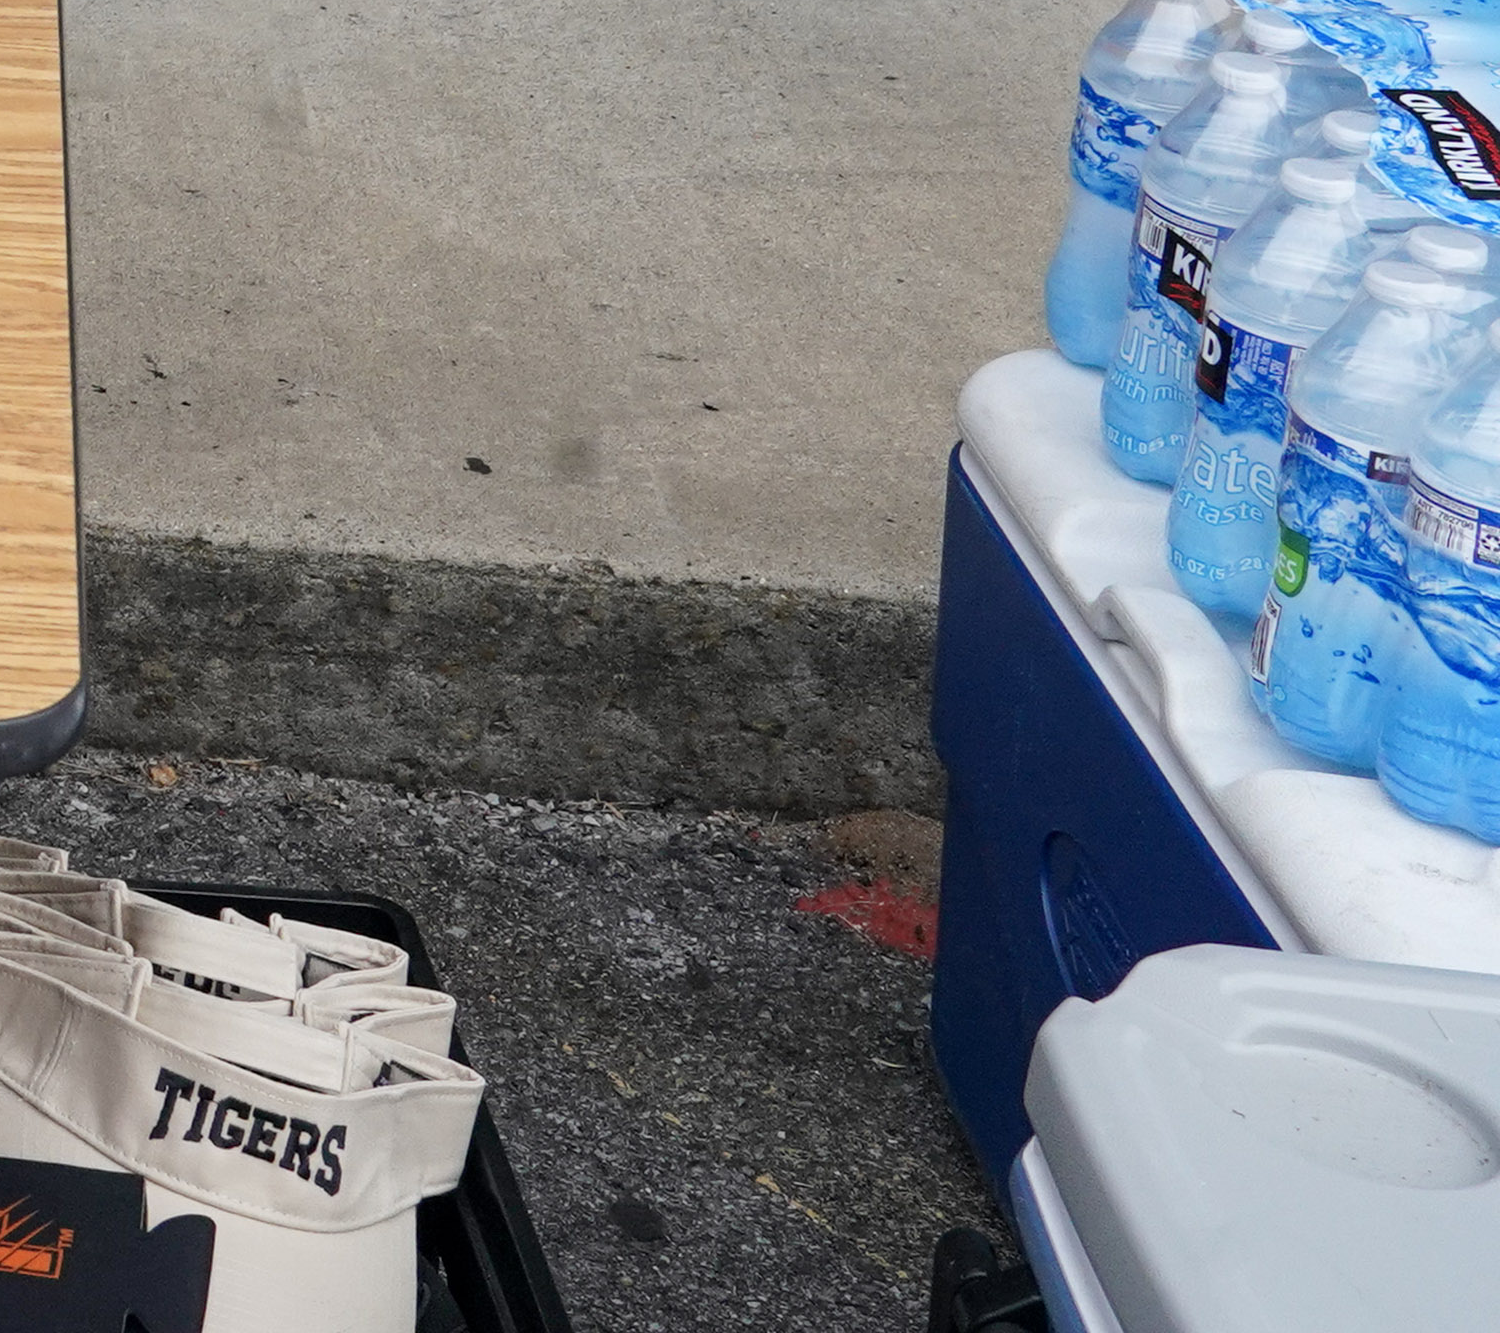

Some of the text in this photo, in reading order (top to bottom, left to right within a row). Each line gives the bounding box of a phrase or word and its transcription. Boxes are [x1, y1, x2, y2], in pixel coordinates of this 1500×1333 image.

[1192, 440, 1279, 508] ate
[1197, 500, 1265, 526] taste
[147, 1067, 349, 1197] TIGERS
